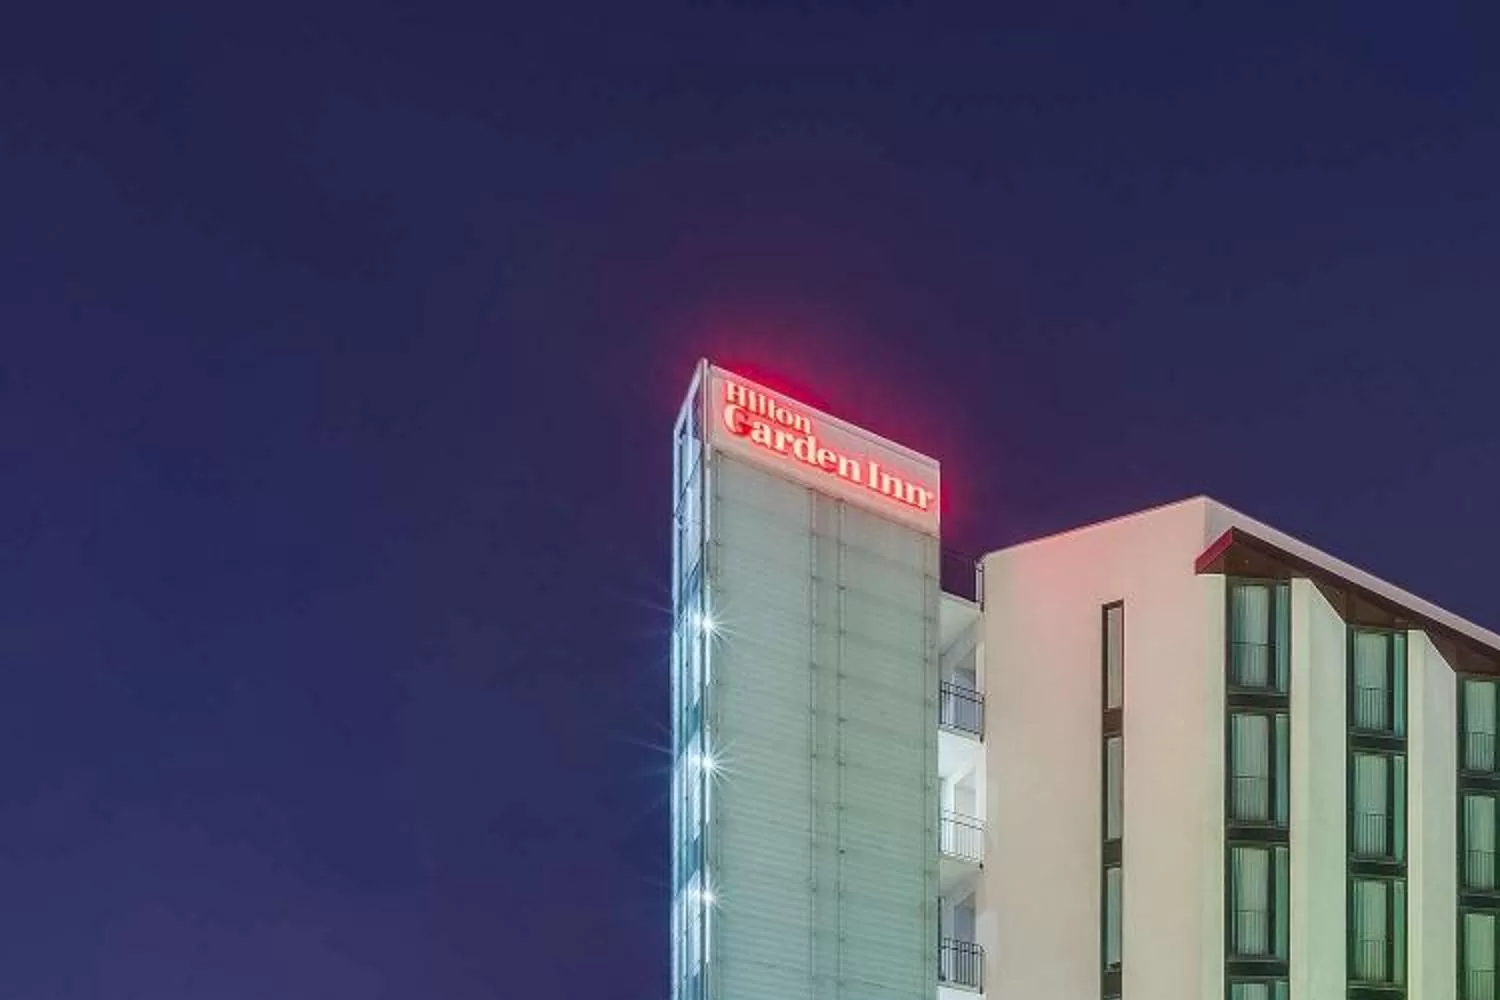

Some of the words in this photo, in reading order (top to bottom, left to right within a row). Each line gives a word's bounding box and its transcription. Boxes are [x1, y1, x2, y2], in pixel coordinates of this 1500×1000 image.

[724, 381, 813, 434] Hilton
[723, 404, 862, 486] Garden
[867, 460, 936, 511] Inn
